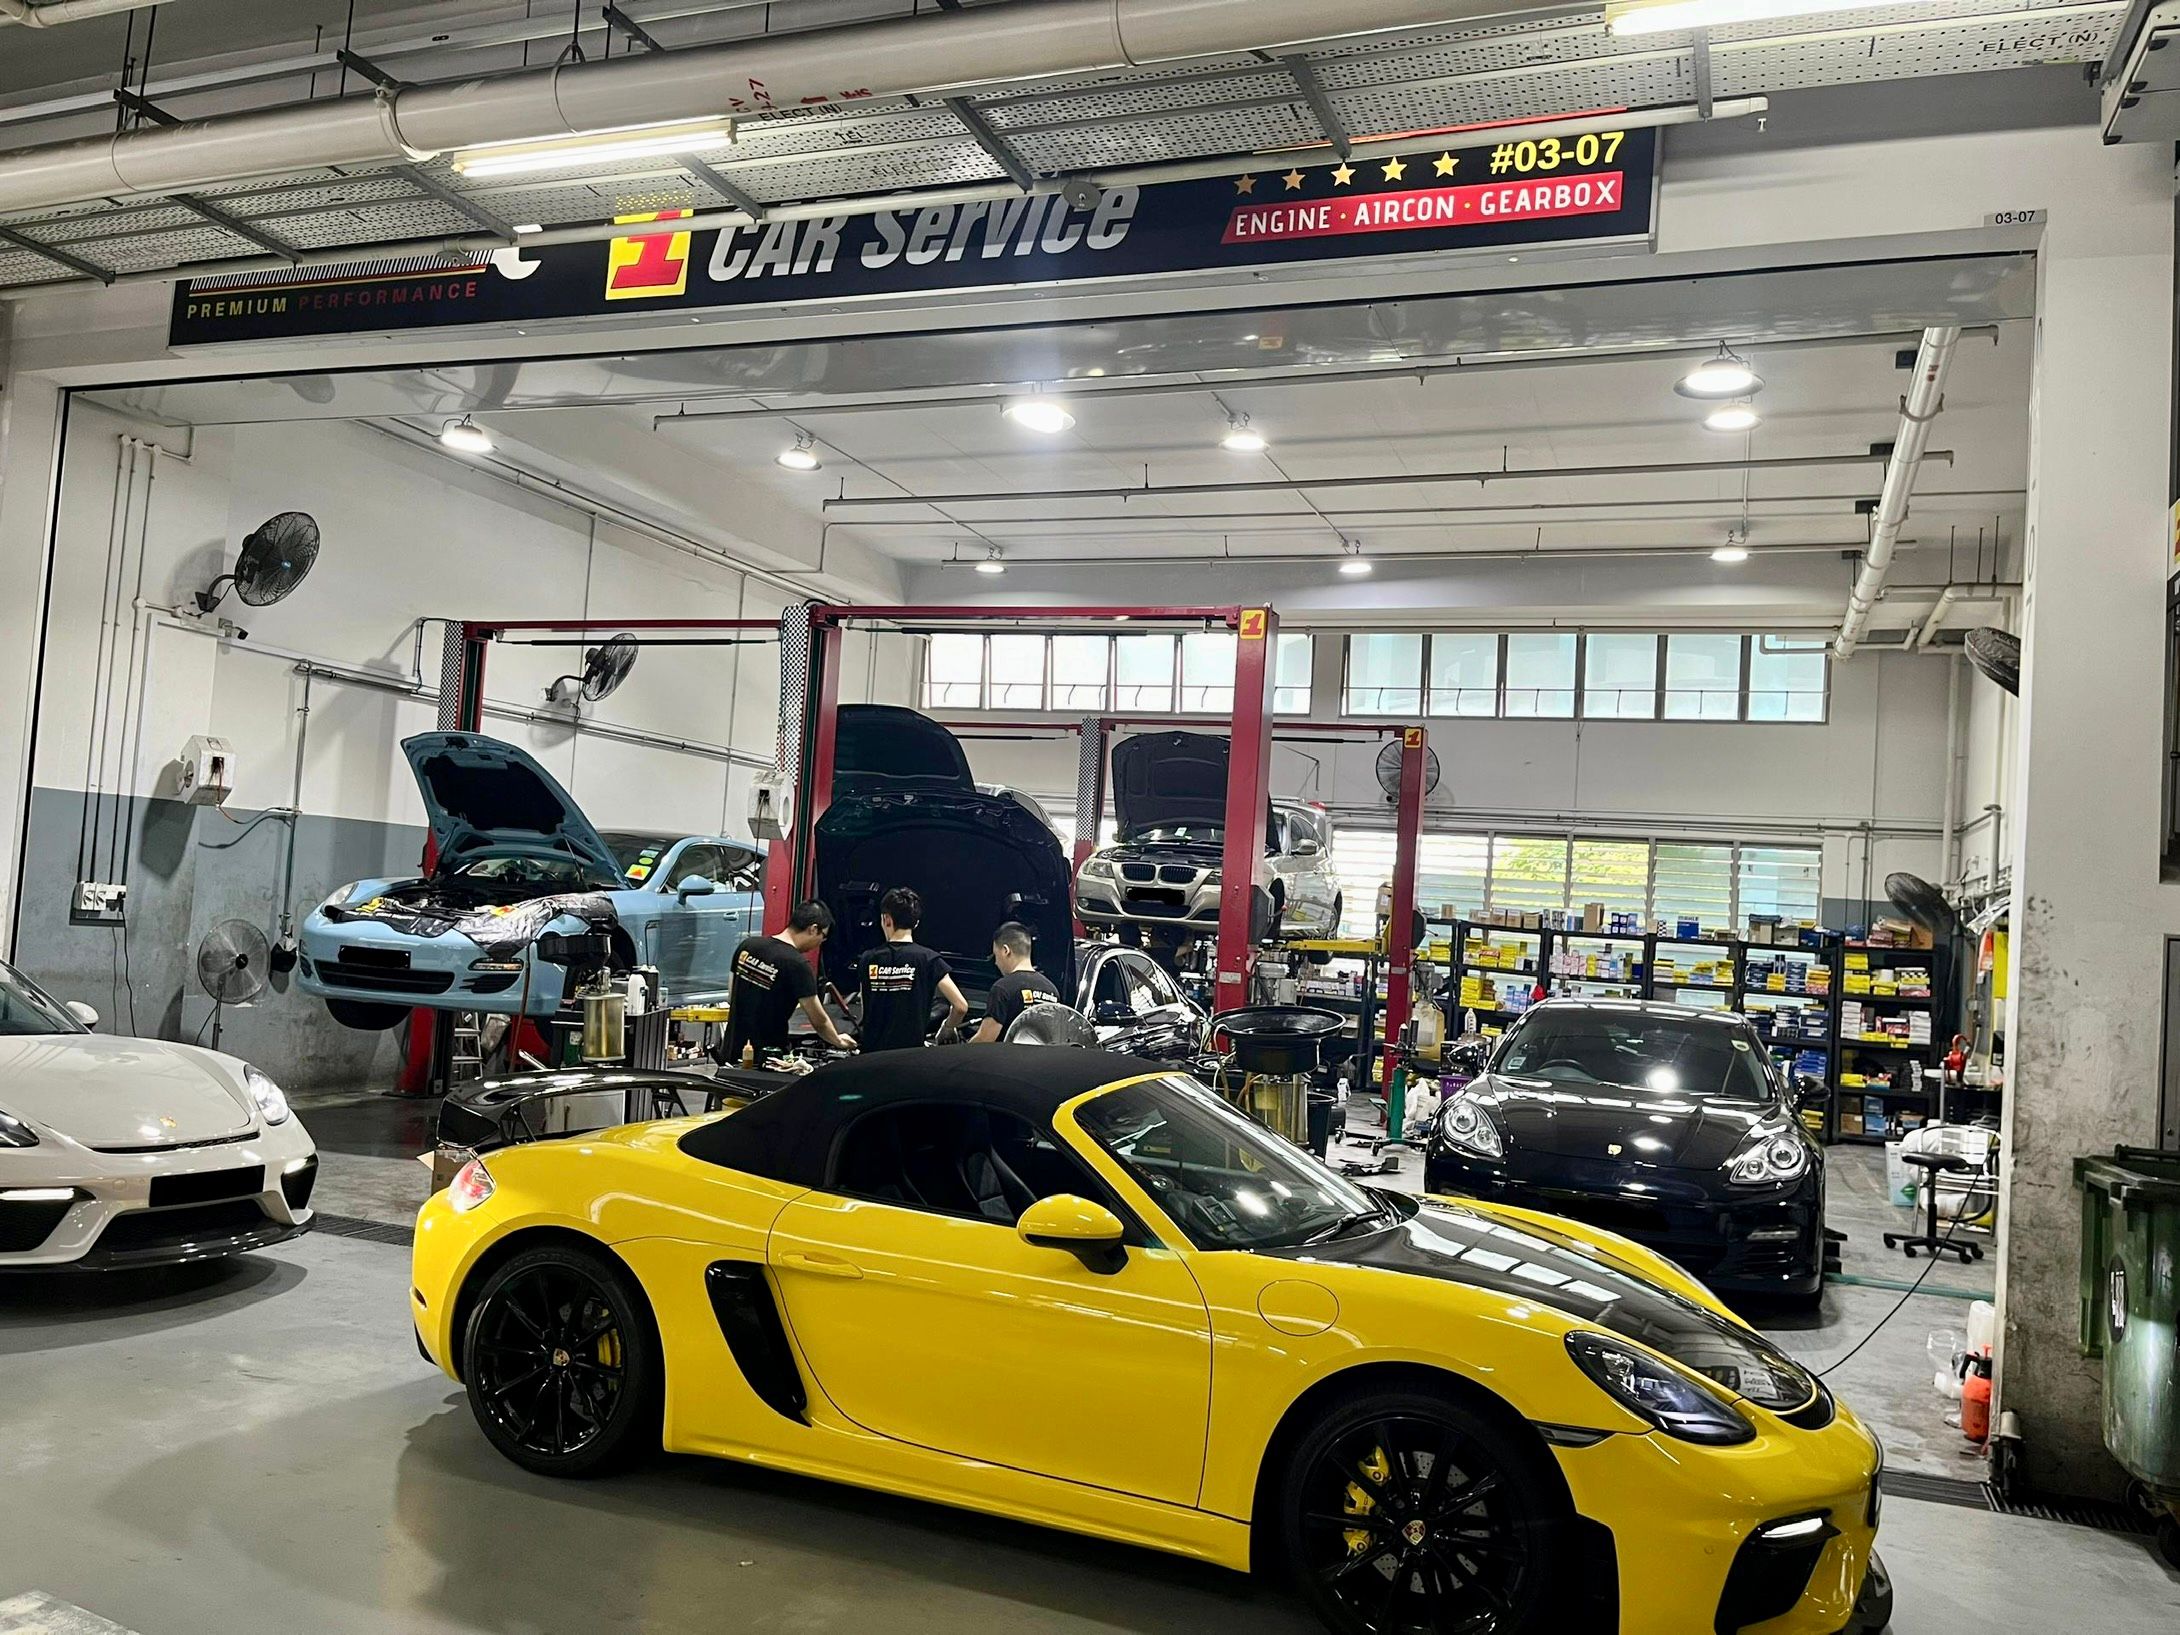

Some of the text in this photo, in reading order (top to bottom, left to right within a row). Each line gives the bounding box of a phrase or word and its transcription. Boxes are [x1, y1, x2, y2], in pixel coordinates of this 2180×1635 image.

[1983, 32, 2098, 51] ELECT (N)
[758, 103, 842, 120] ELECT (N)
[838, 130, 869, 142] TEL
[1490, 131, 1625, 175] #03-07
[1235, 180, 1617, 236] ENGINE AIRCON GEARBOX
[1995, 210, 2035, 225] 03-07
[611, 185, 1140, 290] 1 CAR Service
[187, 281, 479, 319] PREMIUM PERFORMANCE
[1241, 613, 1262, 636] 1
[1405, 730, 1420, 745] 1
[878, 966, 892, 975] CAR
